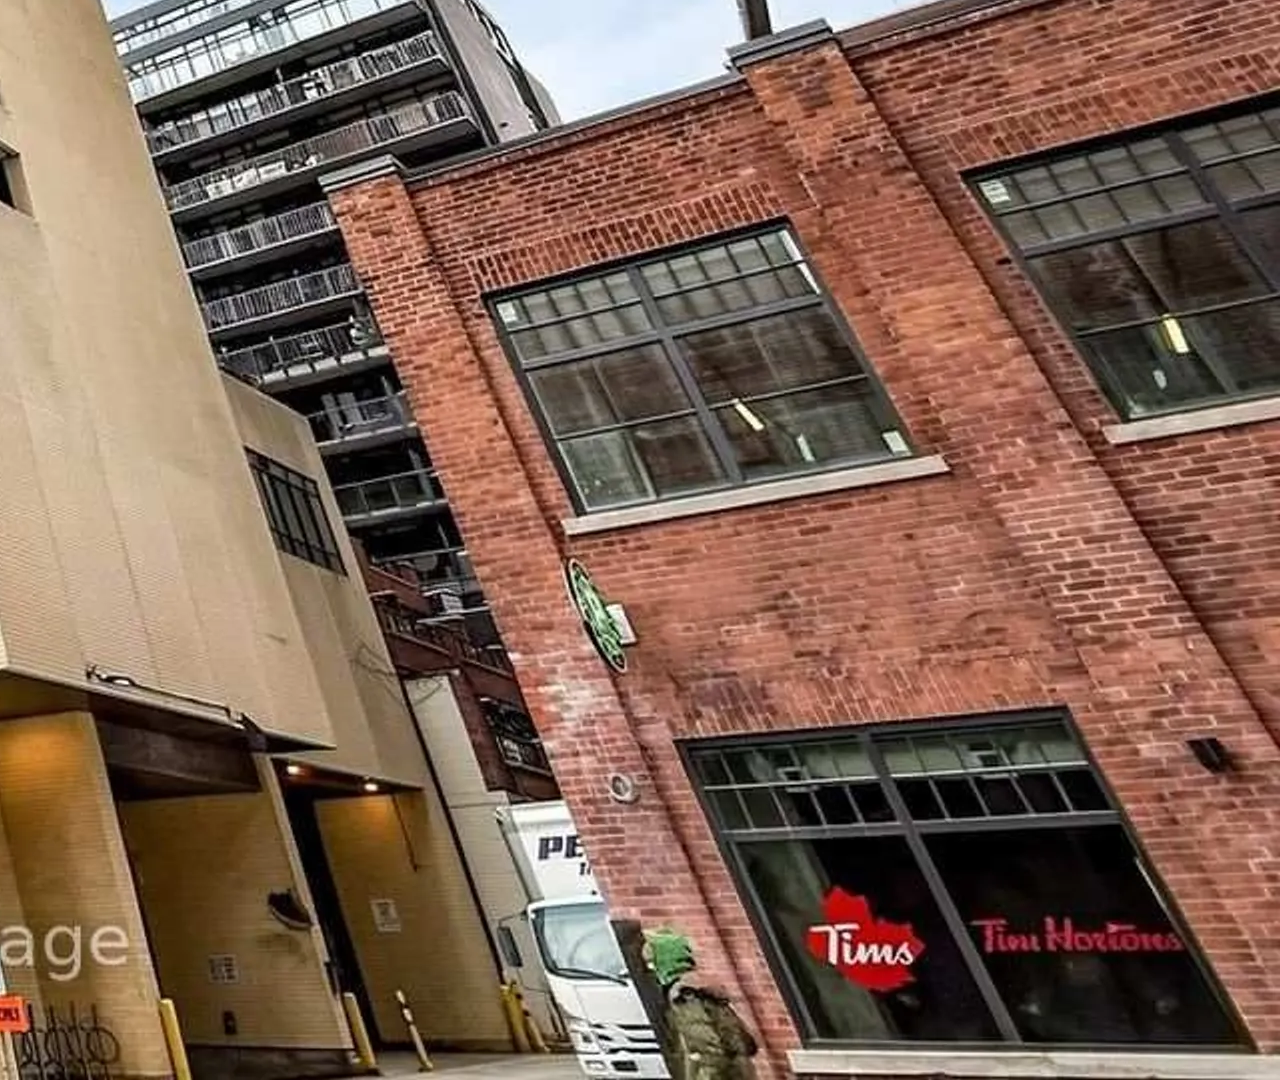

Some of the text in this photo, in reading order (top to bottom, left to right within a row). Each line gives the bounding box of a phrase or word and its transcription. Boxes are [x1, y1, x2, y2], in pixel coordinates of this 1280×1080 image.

[808, 923, 914, 966] Tims
[970, 916, 1185, 953] Tim Hortons
